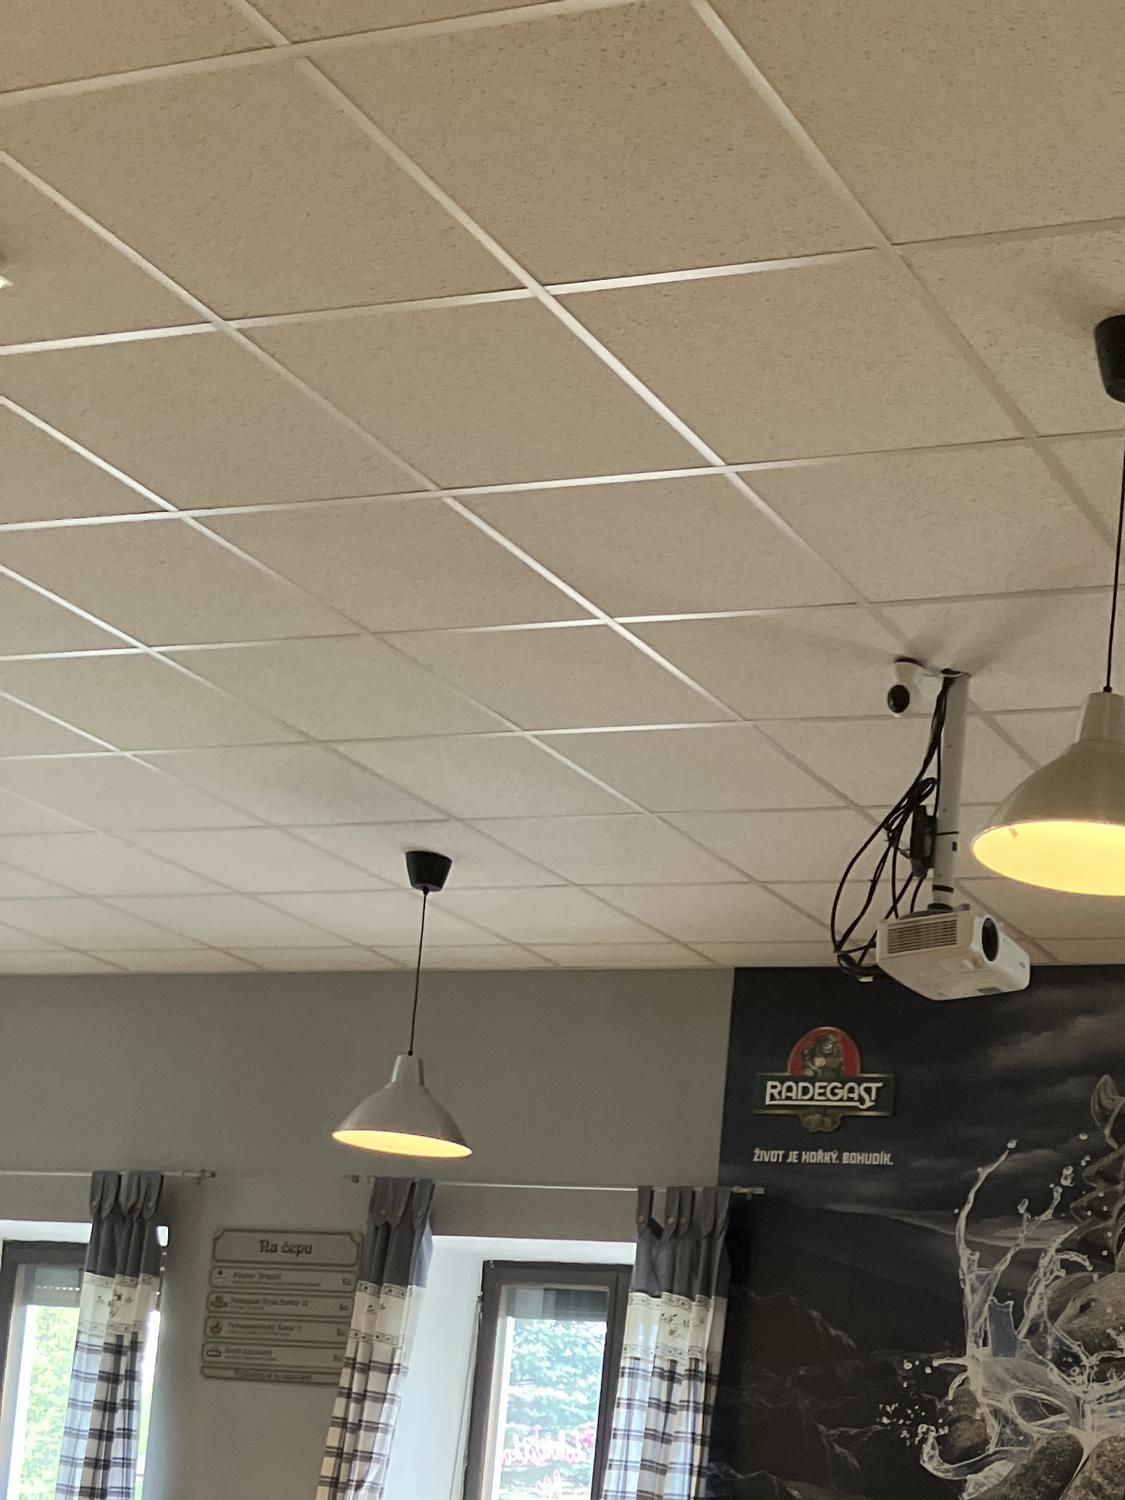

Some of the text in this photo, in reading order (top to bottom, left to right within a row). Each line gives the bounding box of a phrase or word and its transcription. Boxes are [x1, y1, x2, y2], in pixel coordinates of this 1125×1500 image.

[765, 1080, 883, 1109] RADEGAST
[753, 1148, 785, 1162] ŽIVOT
[787, 1151, 799, 1163] JE
[842, 1150, 894, 1165] BOHUDÍK.
